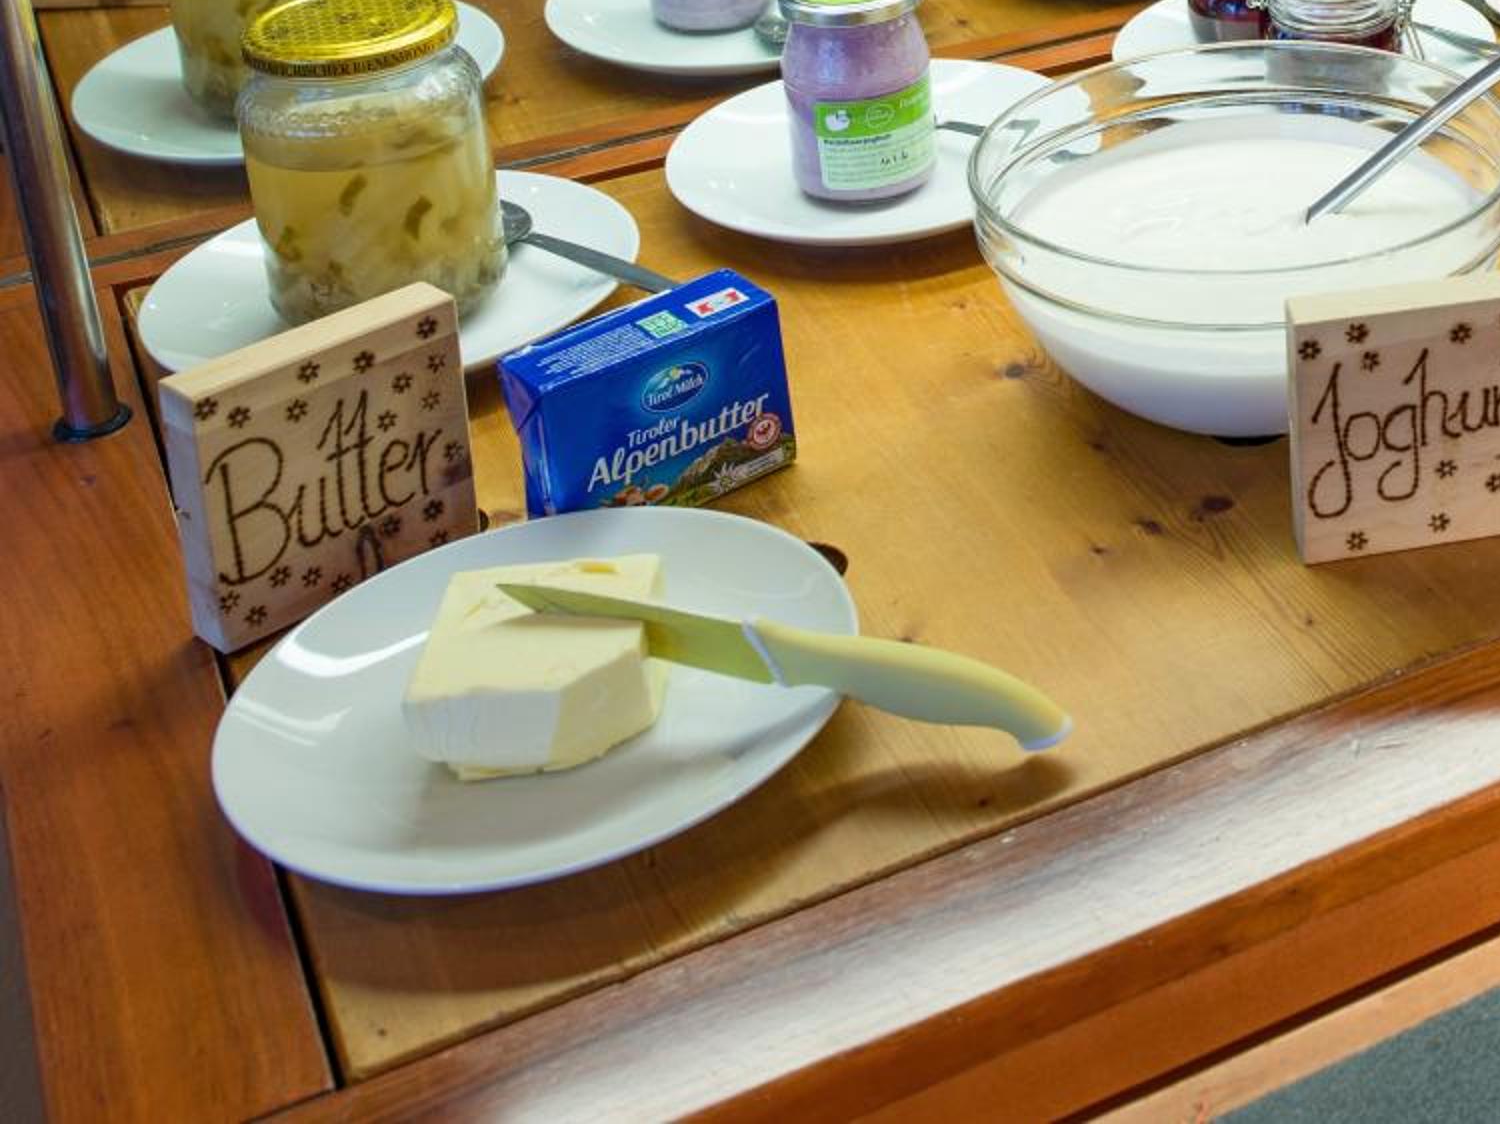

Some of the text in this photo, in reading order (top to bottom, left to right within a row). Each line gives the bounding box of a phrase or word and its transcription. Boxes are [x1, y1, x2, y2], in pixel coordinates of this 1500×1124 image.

[587, 392, 769, 493] Alpenbutter
[627, 415, 681, 449] Tiroler
[204, 388, 443, 585] Butter
